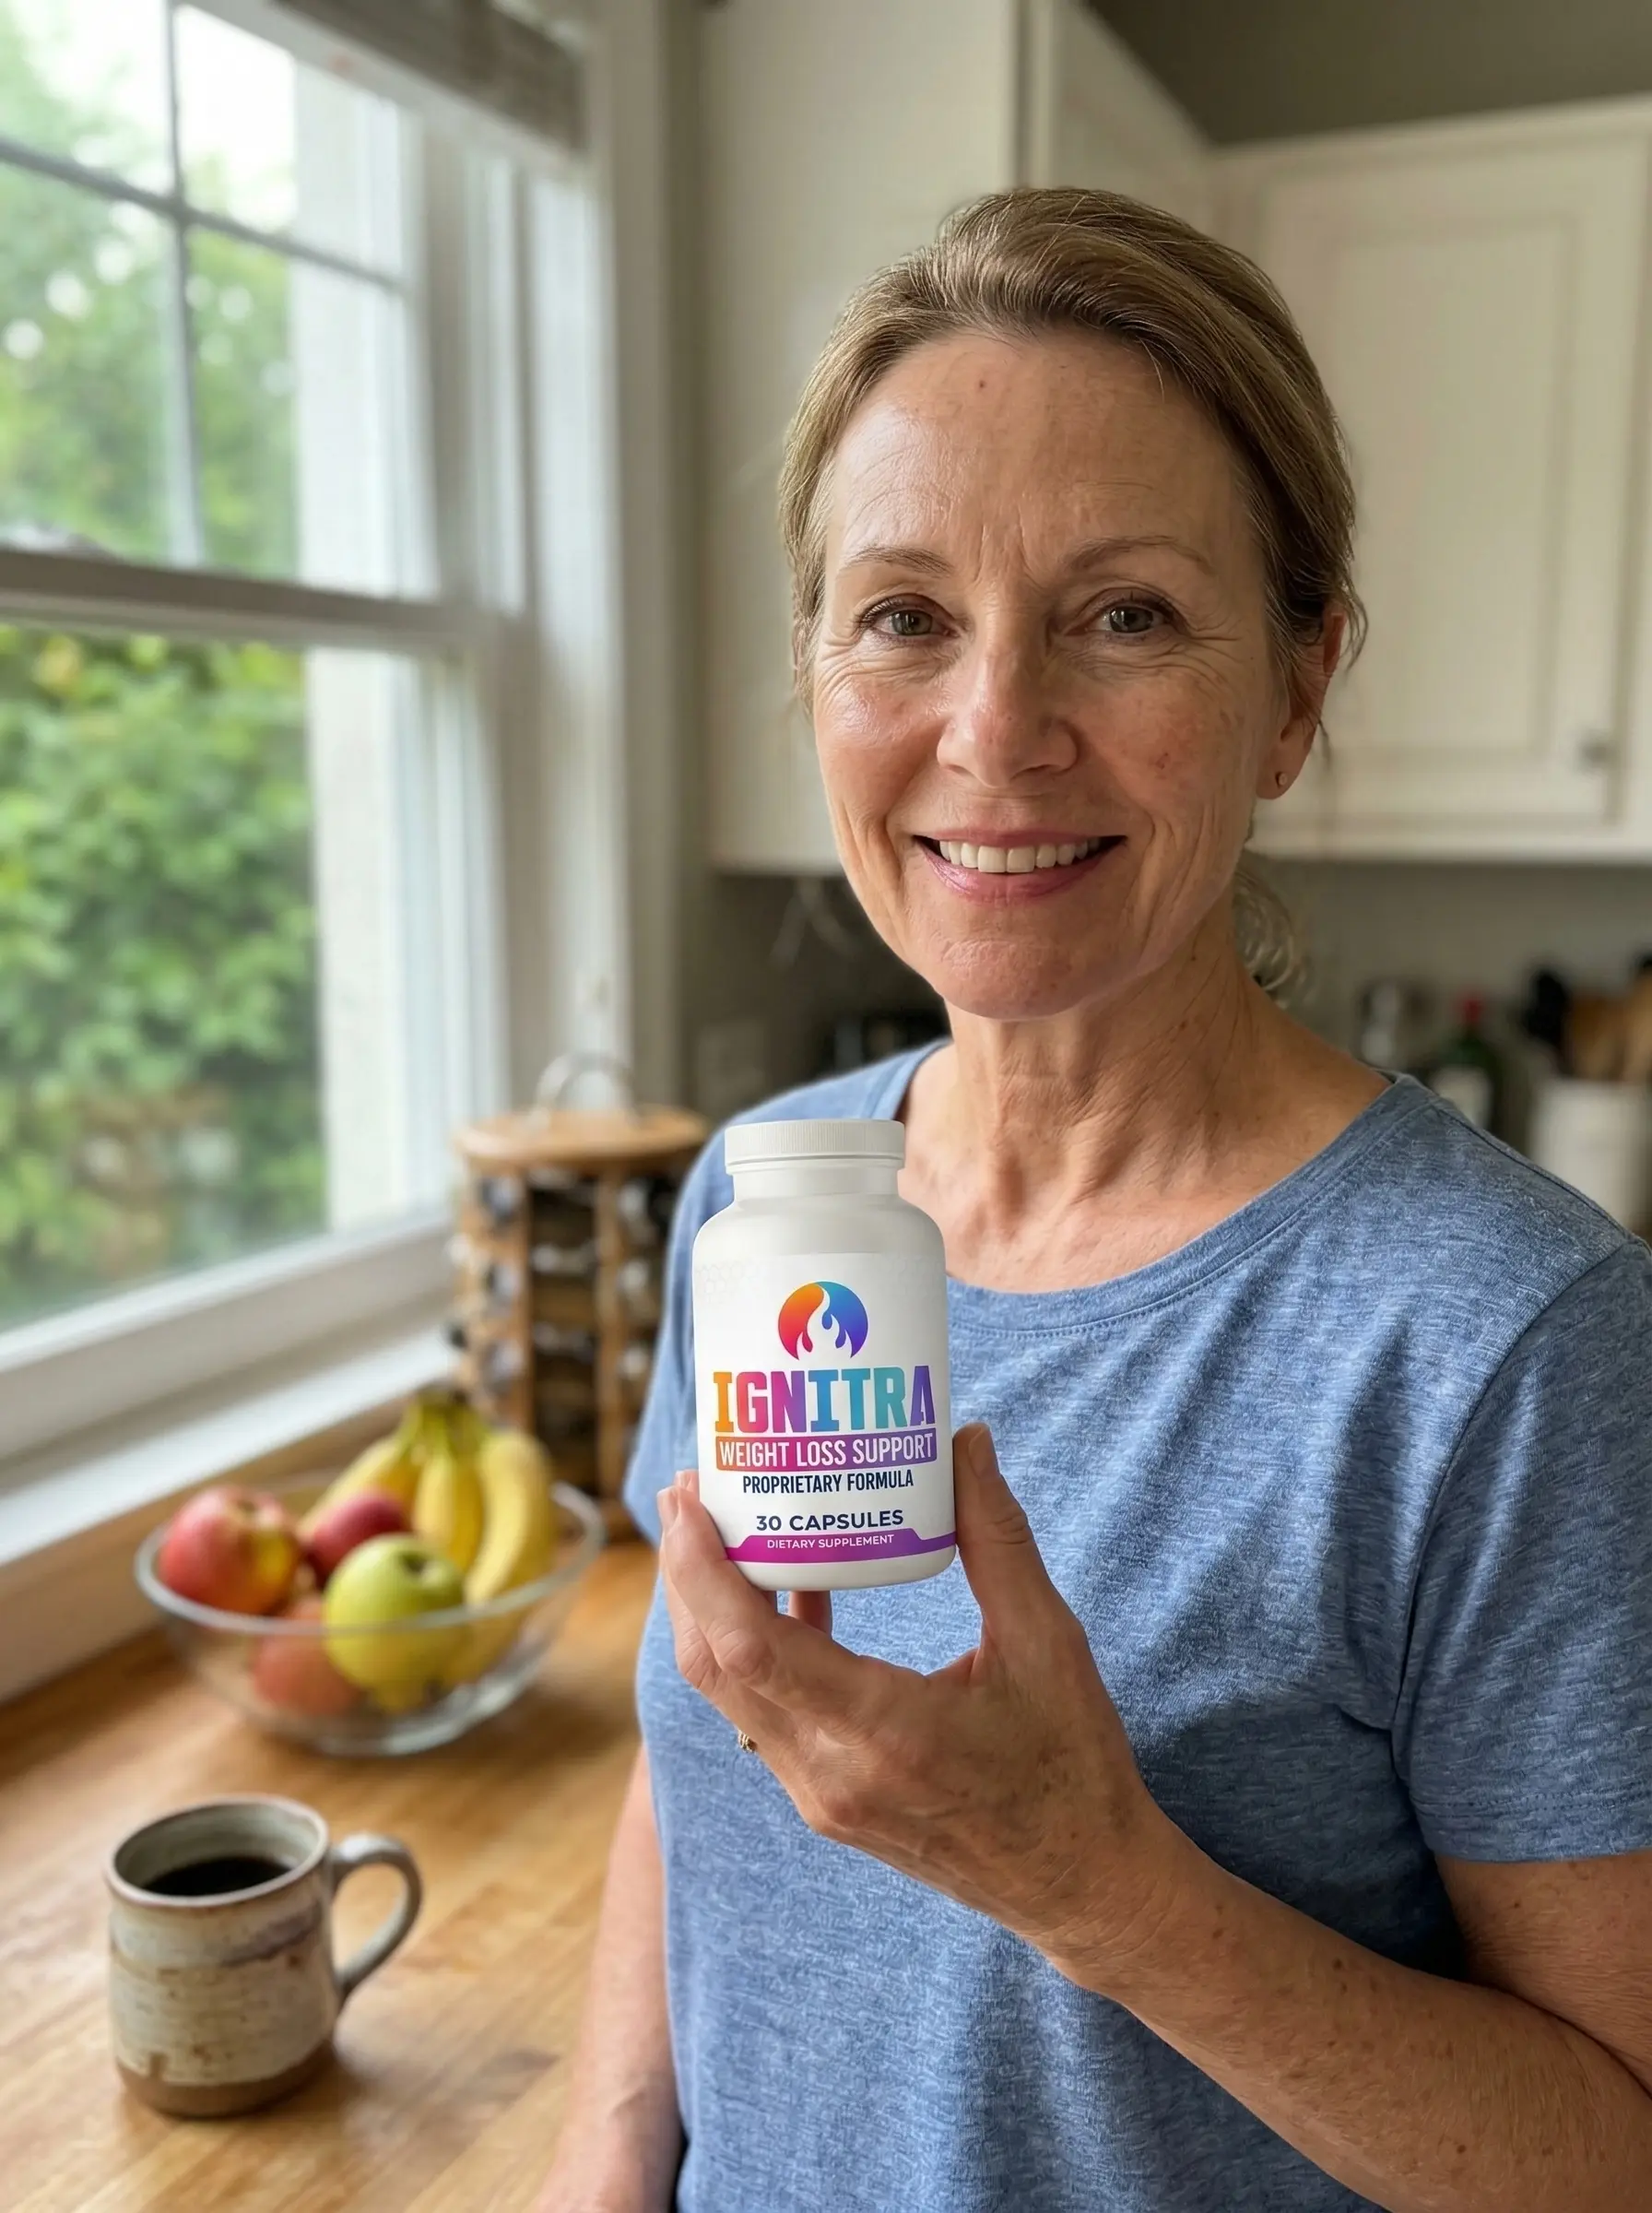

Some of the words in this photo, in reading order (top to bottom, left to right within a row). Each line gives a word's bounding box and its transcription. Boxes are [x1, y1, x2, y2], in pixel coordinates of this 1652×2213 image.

[713, 1366, 936, 1434] IGNITRA
[719, 1440, 790, 1468] WEIGHT
[796, 1438, 846, 1466] LOSS
[852, 1432, 934, 1463] SUPPORT
[742, 1473, 842, 1494] PROPRIETARY
[846, 1470, 914, 1491] FORMULA
[756, 1514, 782, 1532] 30
[788, 1509, 904, 1532] CAPSULES
[767, 1537, 816, 1550] DIETARY
[818, 1534, 894, 1548] SUPPLEMENT
